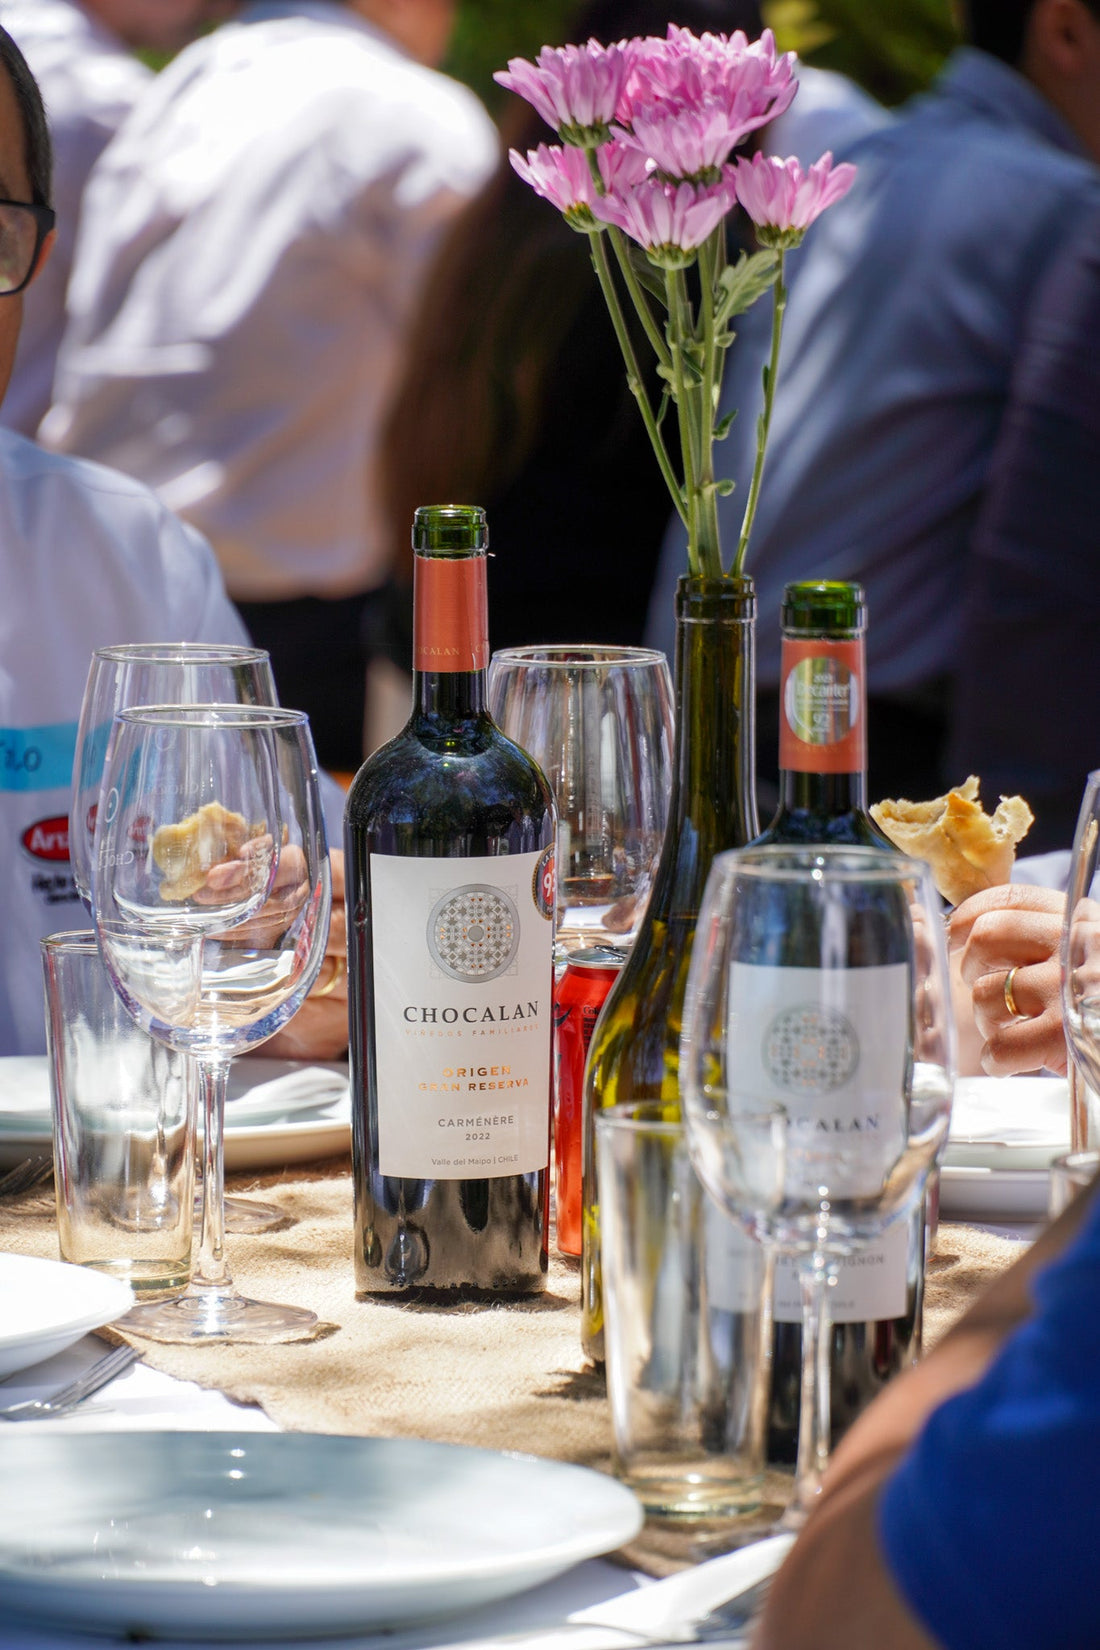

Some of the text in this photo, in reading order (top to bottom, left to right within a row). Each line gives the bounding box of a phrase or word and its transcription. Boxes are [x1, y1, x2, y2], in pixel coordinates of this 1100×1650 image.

[403, 1000, 539, 1024] CHOCALAN
[405, 1023, 540, 1038] VIÑEDOS FAMILIARES
[442, 1065, 512, 1078] ORIGEN
[418, 1078, 529, 1092] GRAN RESERVA
[437, 1115, 515, 1128] CARMÉNÈRE
[465, 1132, 491, 1141] 2022
[431, 1154, 519, 1167] Valle del Maipo CHILE
